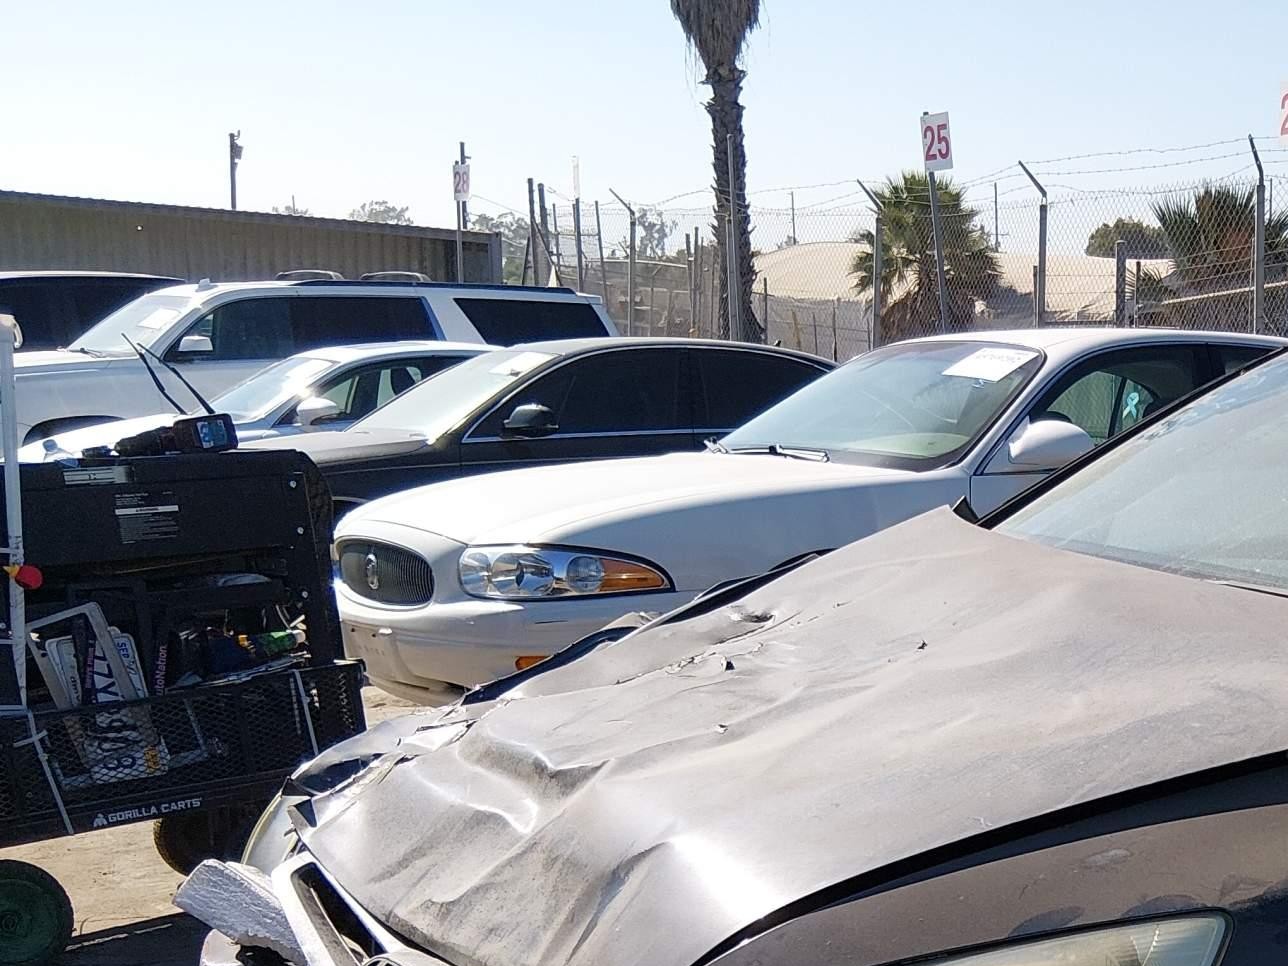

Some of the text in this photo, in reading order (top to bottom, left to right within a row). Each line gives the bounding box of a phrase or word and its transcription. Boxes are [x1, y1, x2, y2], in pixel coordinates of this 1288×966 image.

[924, 123, 950, 161] 25
[154, 645, 168, 697] utoNation
[108, 798, 201, 823] GORILLA CARTS
